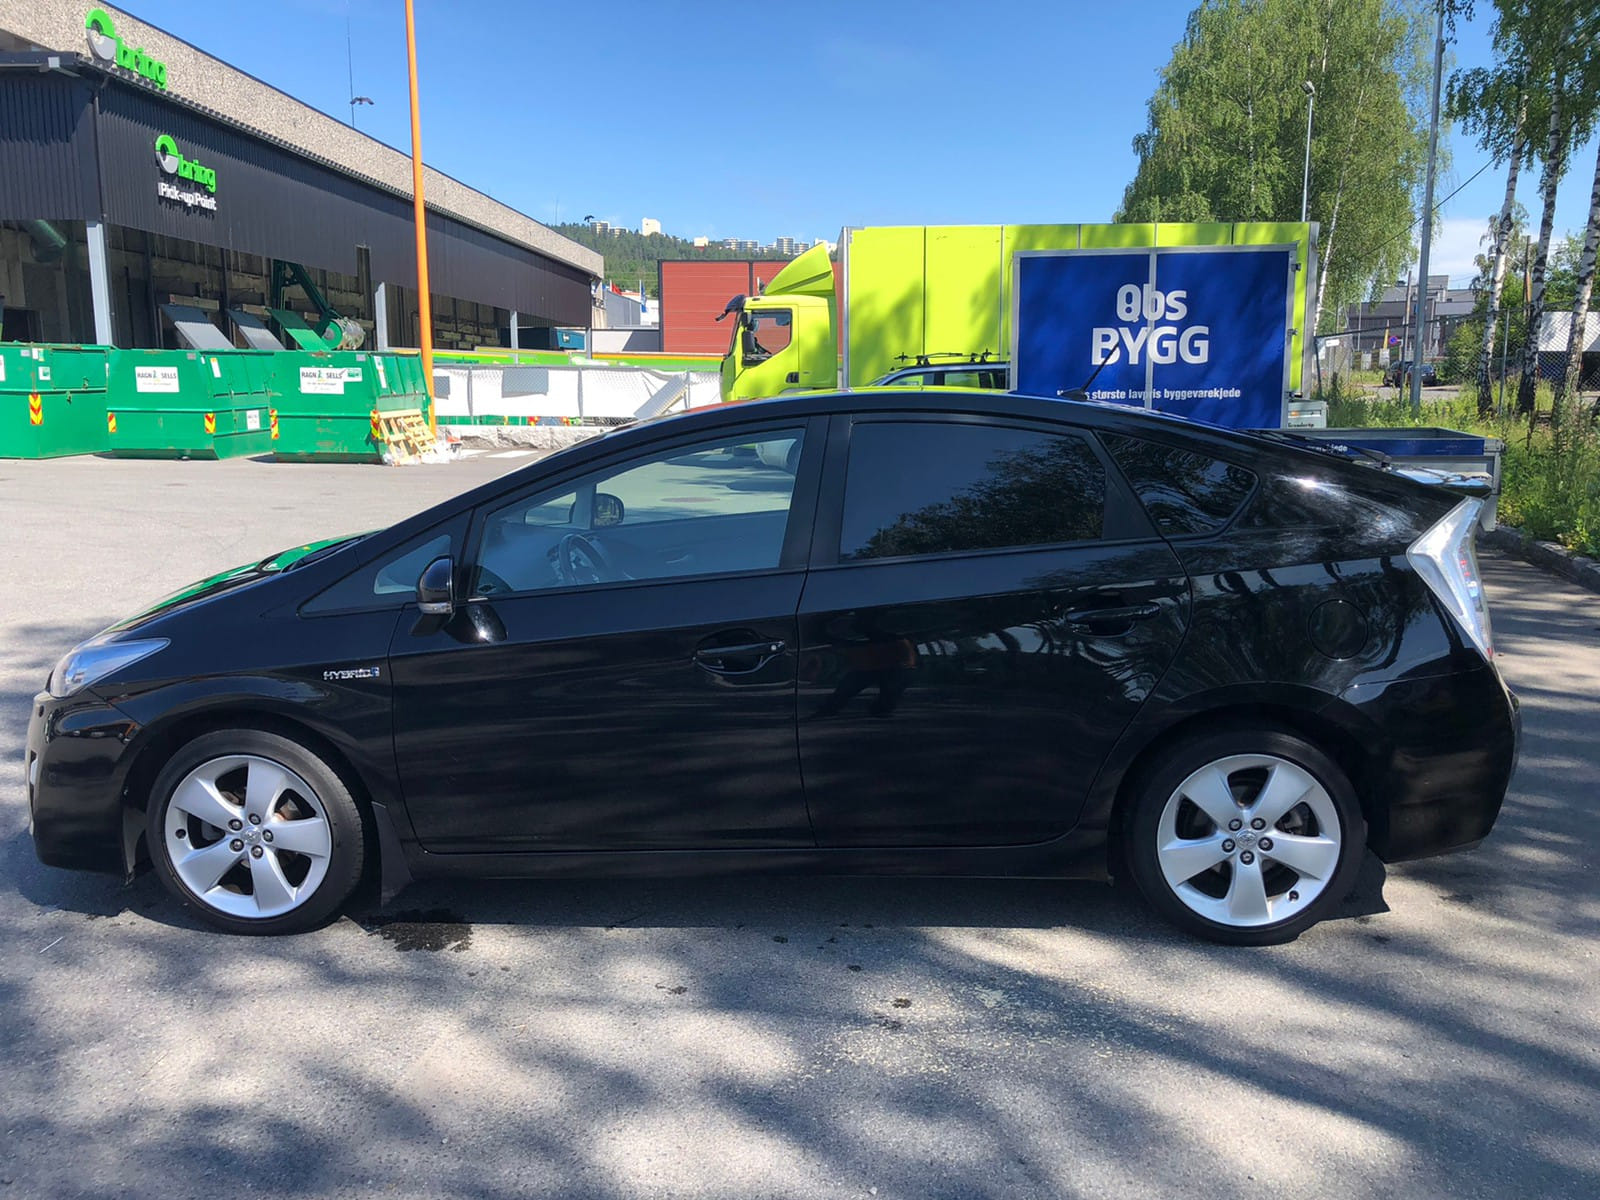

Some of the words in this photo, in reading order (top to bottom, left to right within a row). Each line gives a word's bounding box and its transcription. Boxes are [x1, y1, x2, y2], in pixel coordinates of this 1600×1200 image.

[116, 36, 167, 91] bring
[178, 153, 216, 193] bring
[158, 182, 194, 207] Pick-up
[193, 192, 217, 210] Point
[1091, 325, 1209, 365] BYGG
[1091, 389, 1126, 400] største
[1163, 388, 1241, 401] byggevarekjede
[323, 669, 371, 680] HYBRID
